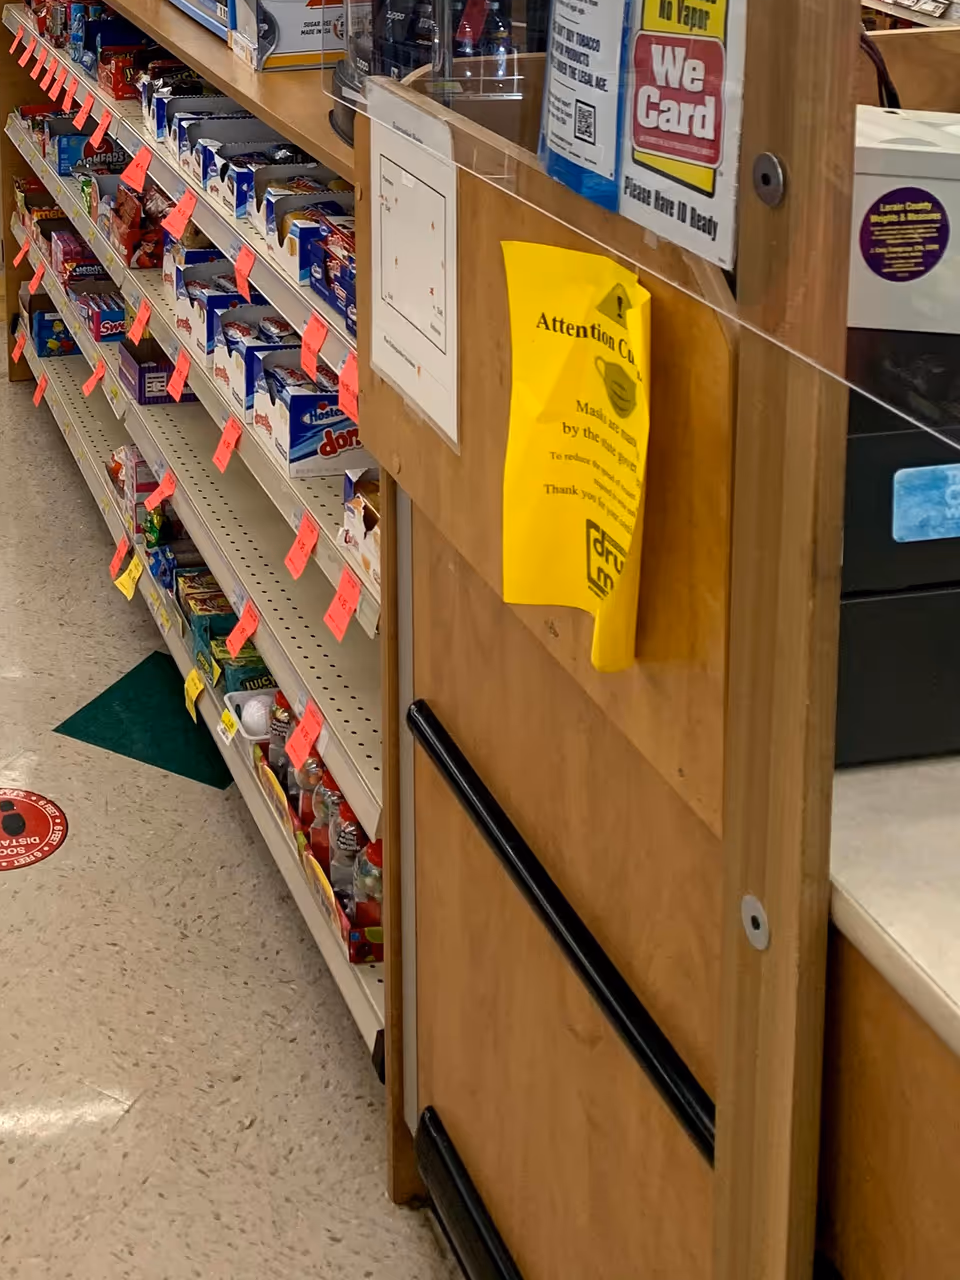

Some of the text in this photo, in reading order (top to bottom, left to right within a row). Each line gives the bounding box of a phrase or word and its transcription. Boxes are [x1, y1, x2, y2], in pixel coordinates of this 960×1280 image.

[303, 21, 321, 29] SUGAR
[651, 43, 705, 92] We
[637, 85, 715, 140] Card
[624, 176, 718, 241] Please Have ID Ready
[536, 311, 615, 352] Attention
[562, 422, 600, 444] by the
[550, 451, 590, 465] To reduce
[544, 484, 597, 504] Thank you
[14, 855, 35, 866] FEET
